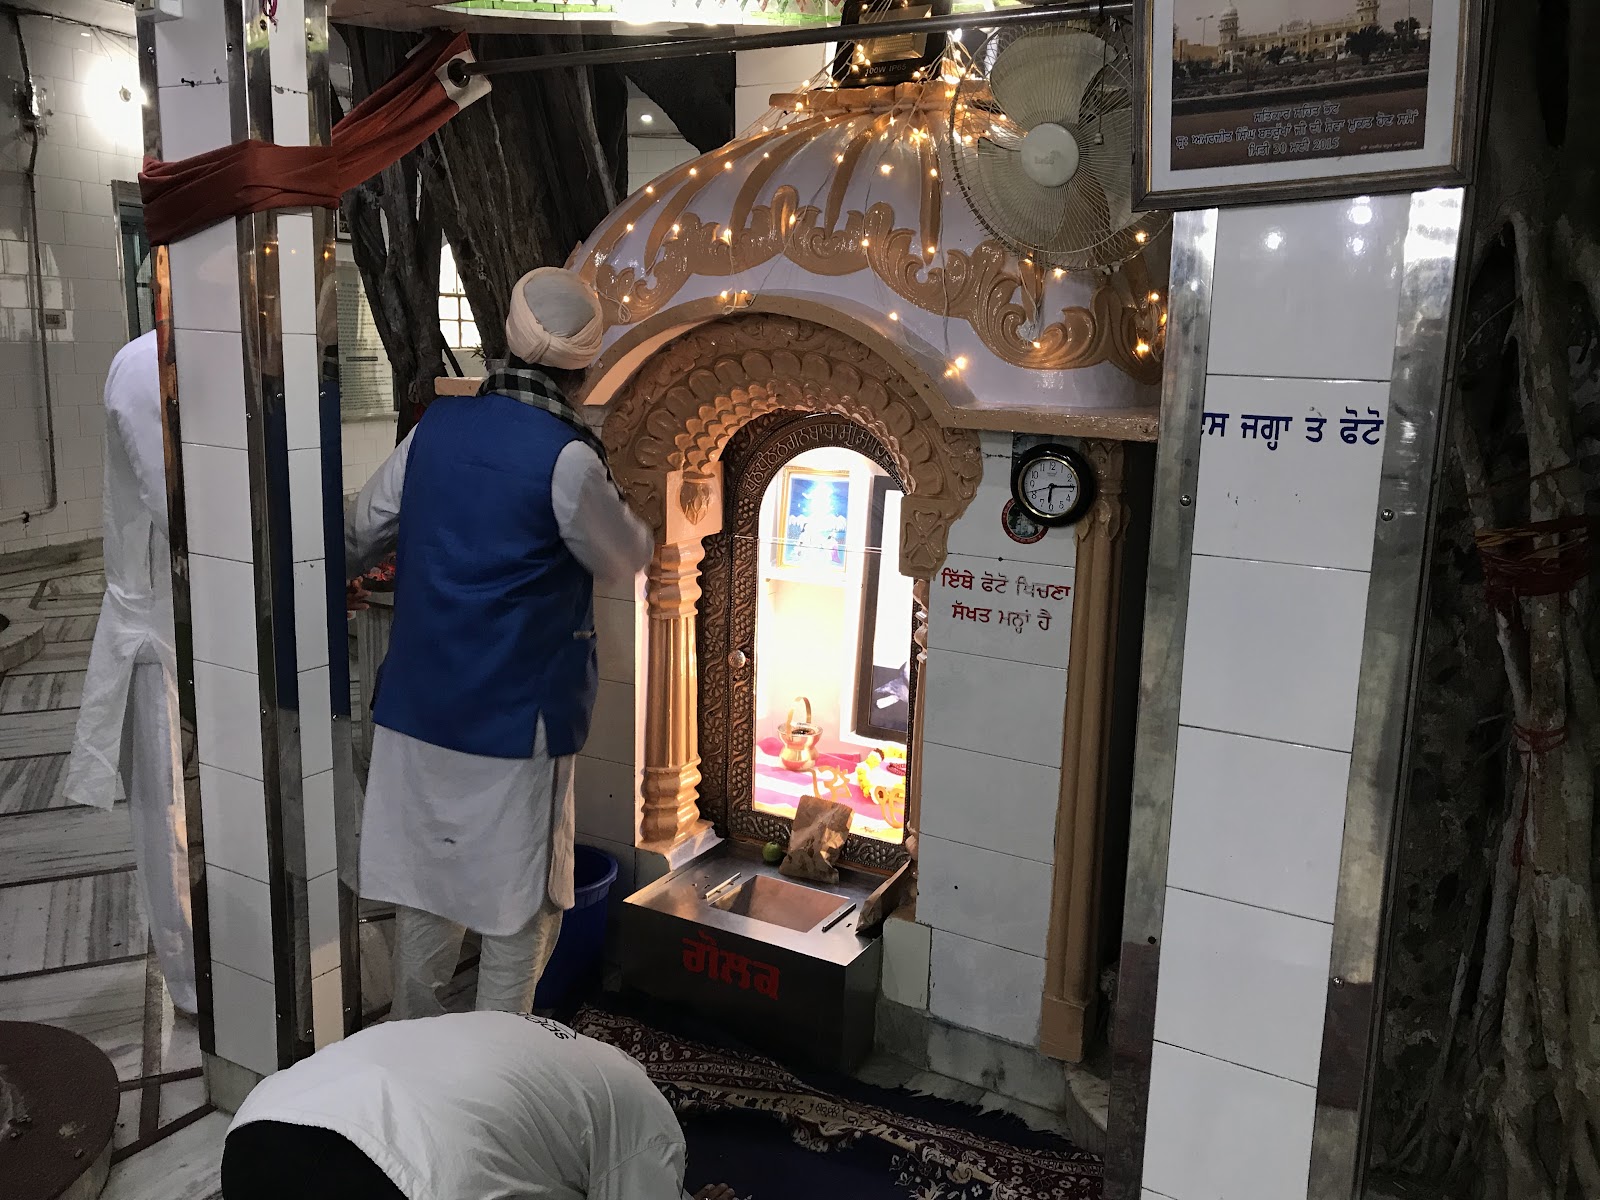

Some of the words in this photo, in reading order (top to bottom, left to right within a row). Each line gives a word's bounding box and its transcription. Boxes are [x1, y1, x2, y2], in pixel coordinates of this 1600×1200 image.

[1294, 120, 1308, 136] ਜੀ
[1272, 143, 1287, 154] 30
[1312, 137, 1340, 151] 2015
[1339, 406, 1384, 445] ਫੋਟੋ
[981, 571, 1009, 593] ਫੋਟੋ
[1037, 608, 1052, 631] ਹੈ
